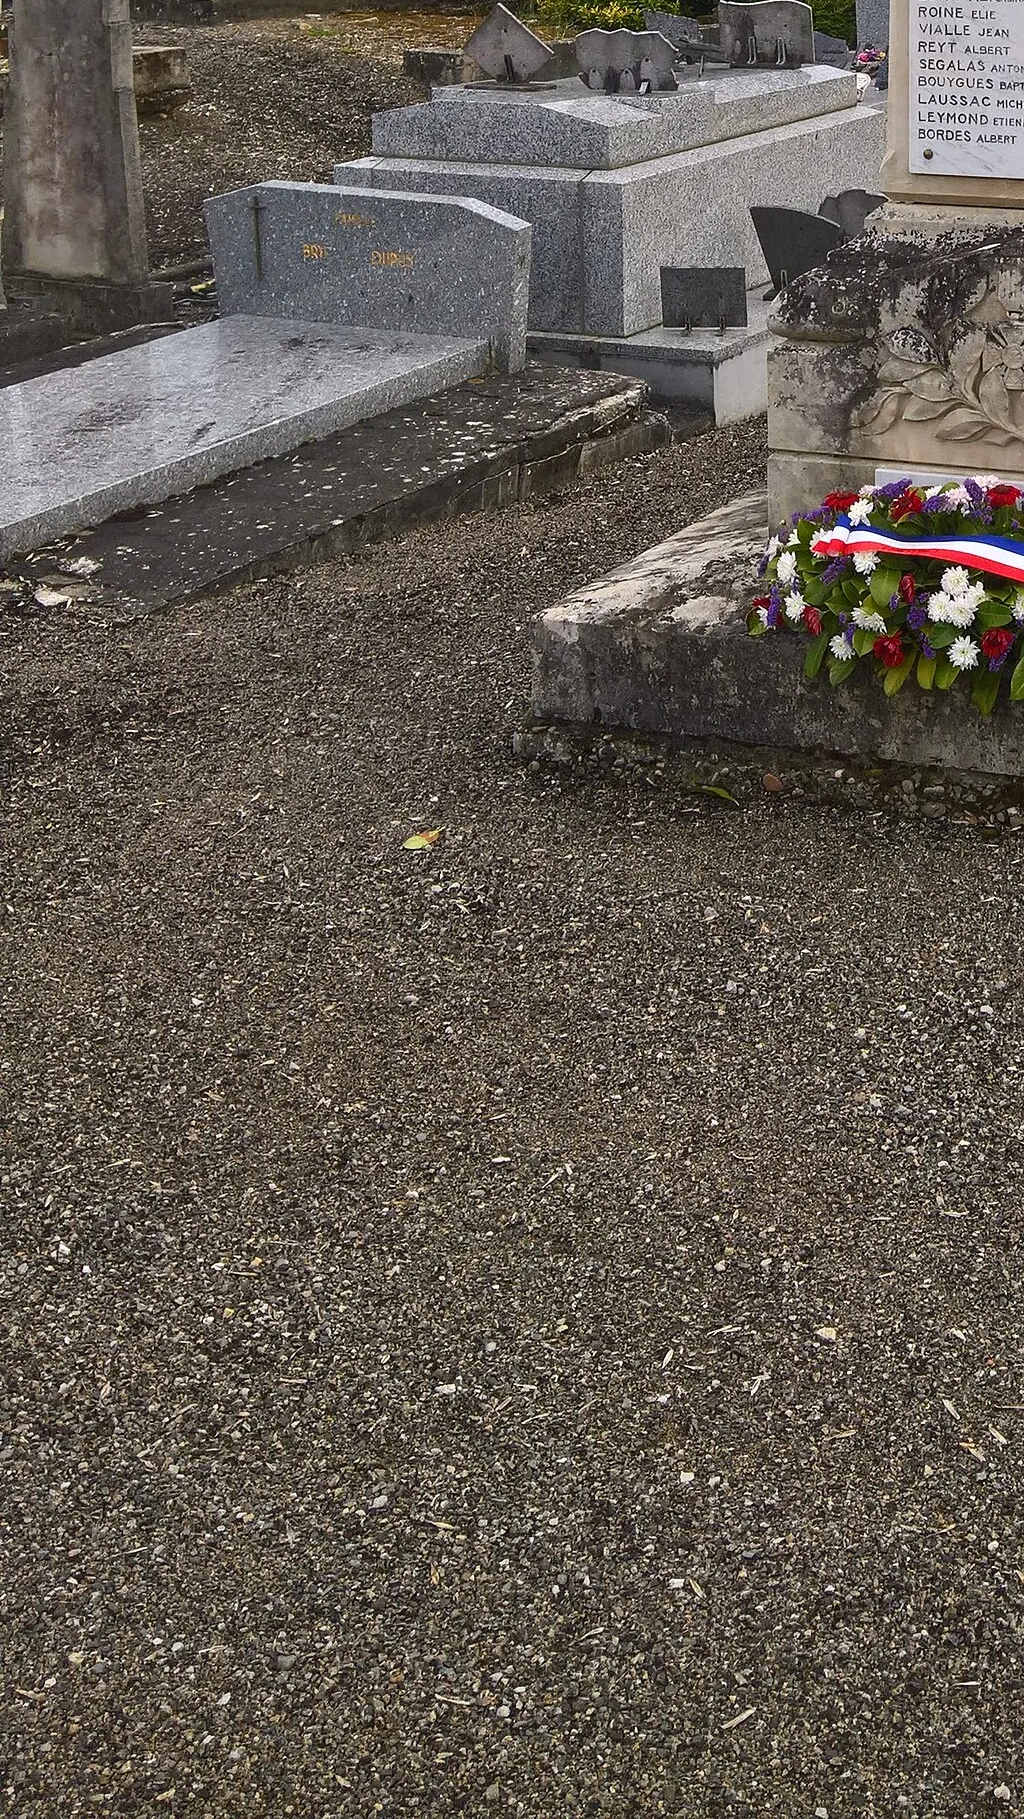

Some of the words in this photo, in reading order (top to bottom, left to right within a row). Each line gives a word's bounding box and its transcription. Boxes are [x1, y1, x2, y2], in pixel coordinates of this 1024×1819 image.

[918, 6, 964, 18] ROINE
[971, 10, 996, 20] ELIE
[919, 23, 971, 36] VIALLE
[978, 28, 1010, 38] JEAN
[918, 41, 957, 53] REYT
[964, 45, 1011, 55] ALBERT
[919, 59, 986, 71] SEGALAS
[918, 76, 994, 89] BOUYGUES
[918, 93, 991, 107] LAUSSAC
[918, 111, 989, 125] LEYMOND
[918, 128, 972, 142] BORDES
[976, 134, 1017, 144] ALBERT
